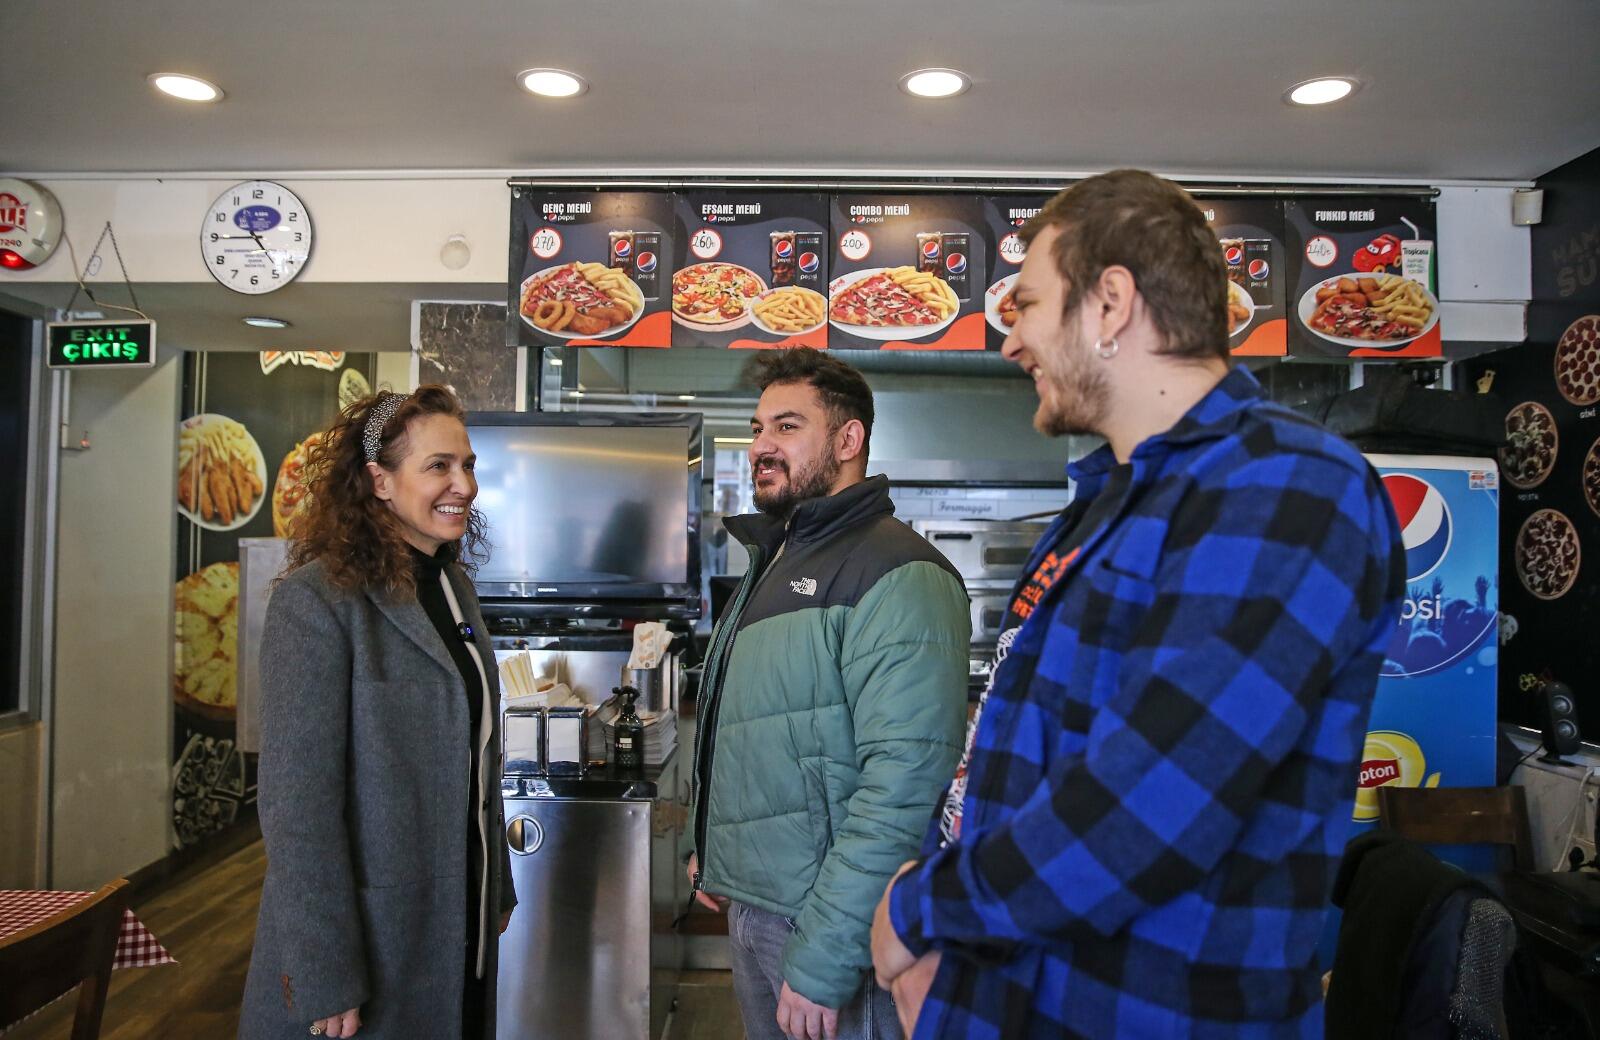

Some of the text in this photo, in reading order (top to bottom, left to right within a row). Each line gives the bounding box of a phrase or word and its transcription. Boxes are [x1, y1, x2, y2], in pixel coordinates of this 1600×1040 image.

[252, 189, 264, 199] 12
[233, 196, 240, 206] 11
[542, 202, 592, 216] GENÇ MENÜ
[702, 202, 761, 215] EFSANE MENÜ
[850, 203, 910, 216] COMBO MENÜ
[216, 212, 226, 222] 10
[288, 212, 297, 222] 2
[717, 215, 736, 223] pepsi
[866, 216, 884, 224] pepsi
[1315, 208, 1376, 222] FUNKID MENÜ
[210, 232, 219, 243] 9
[294, 232, 302, 242] 3
[1402, 247, 1429, 256] Tropicana
[216, 255, 225, 265] 8
[231, 269, 239, 279] 7
[271, 269, 280, 279] 5
[250, 275, 258, 285] 6
[62, 341, 139, 362] ÇIKIŞ
[938, 501, 993, 514] Formaggio
[1358, 765, 1395, 785] pton
